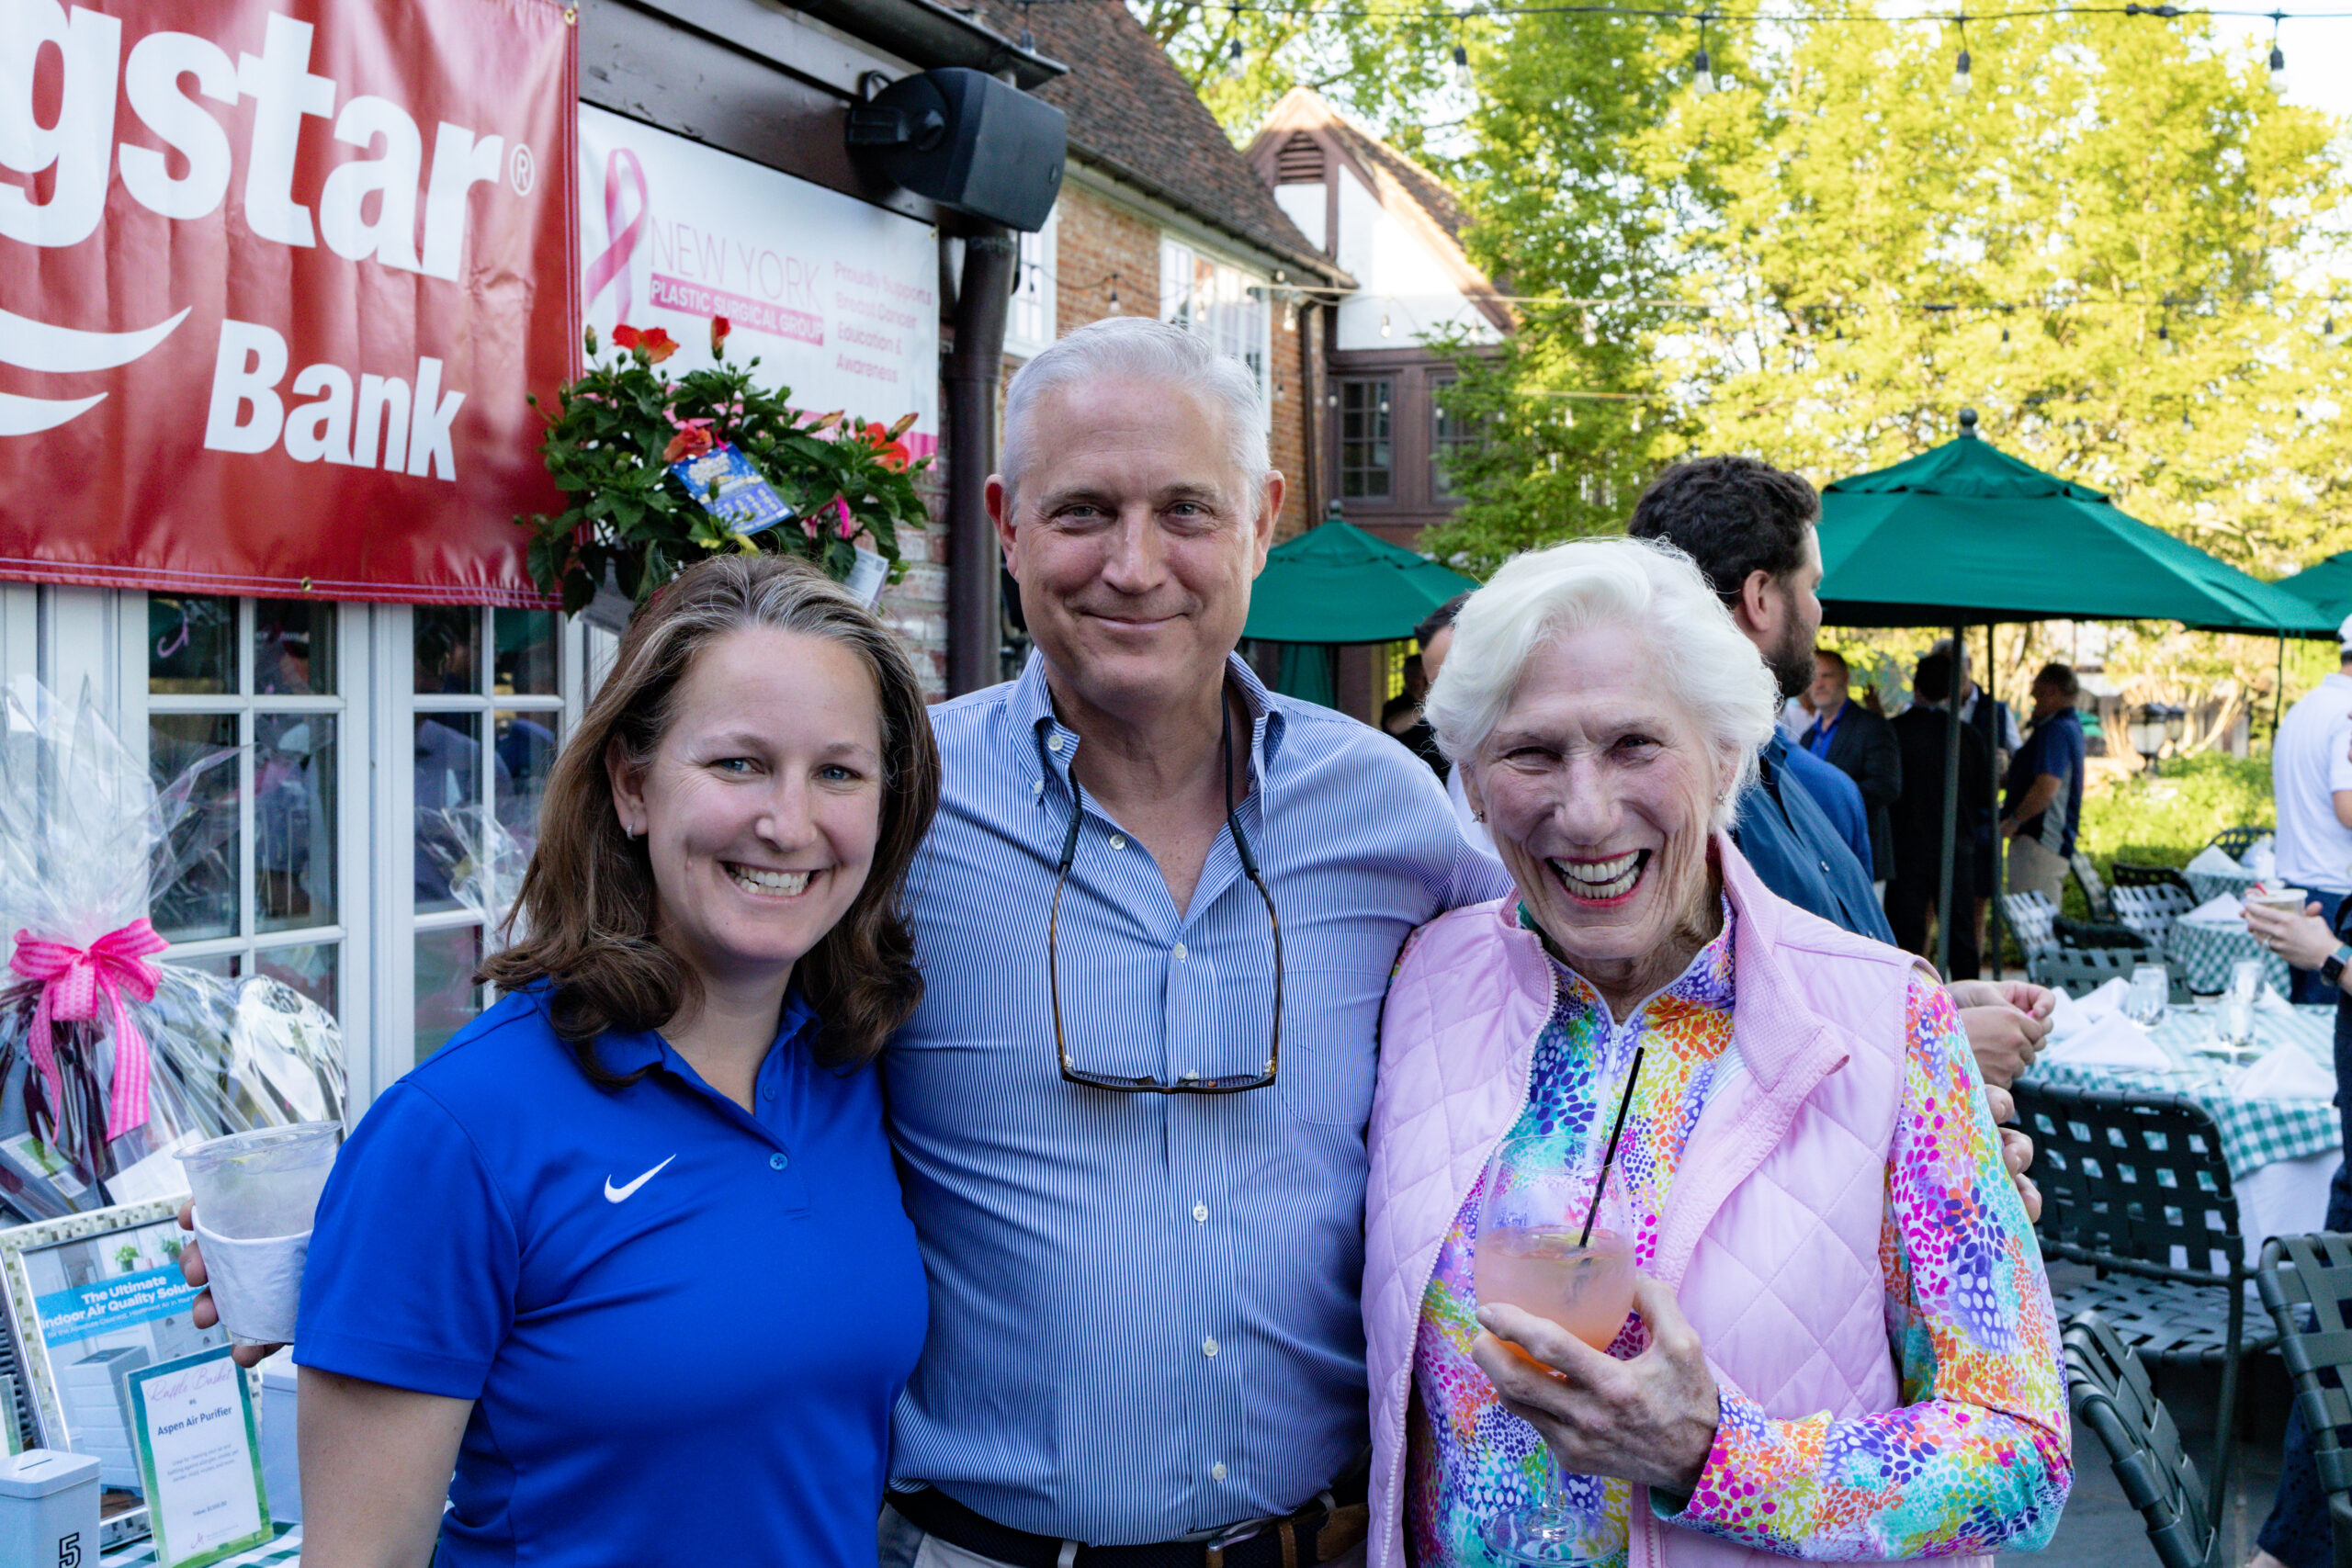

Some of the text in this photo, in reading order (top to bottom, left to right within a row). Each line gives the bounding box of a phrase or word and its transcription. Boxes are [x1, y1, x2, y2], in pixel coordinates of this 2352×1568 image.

[650, 215, 823, 311] NEW YORK
[833, 260, 932, 307] Proudly Supports
[650, 280, 824, 340] PLASTIC SURGICAL GROUP
[836, 291, 918, 330] Breast Cancer
[838, 321, 894, 353] Education
[837, 353, 899, 384] Awareness
[204, 318, 467, 482] Bank
[81, 1276, 167, 1304] The Ultimate
[40, 1310, 85, 1329] Indoor
[87, 1303, 107, 1318] Air
[107, 1292, 156, 1312] Quality
[147, 1360, 233, 1402] Raffle Basket
[157, 1406, 232, 1436] Aspen Air Purifier
[59, 1531, 82, 1568] 5
